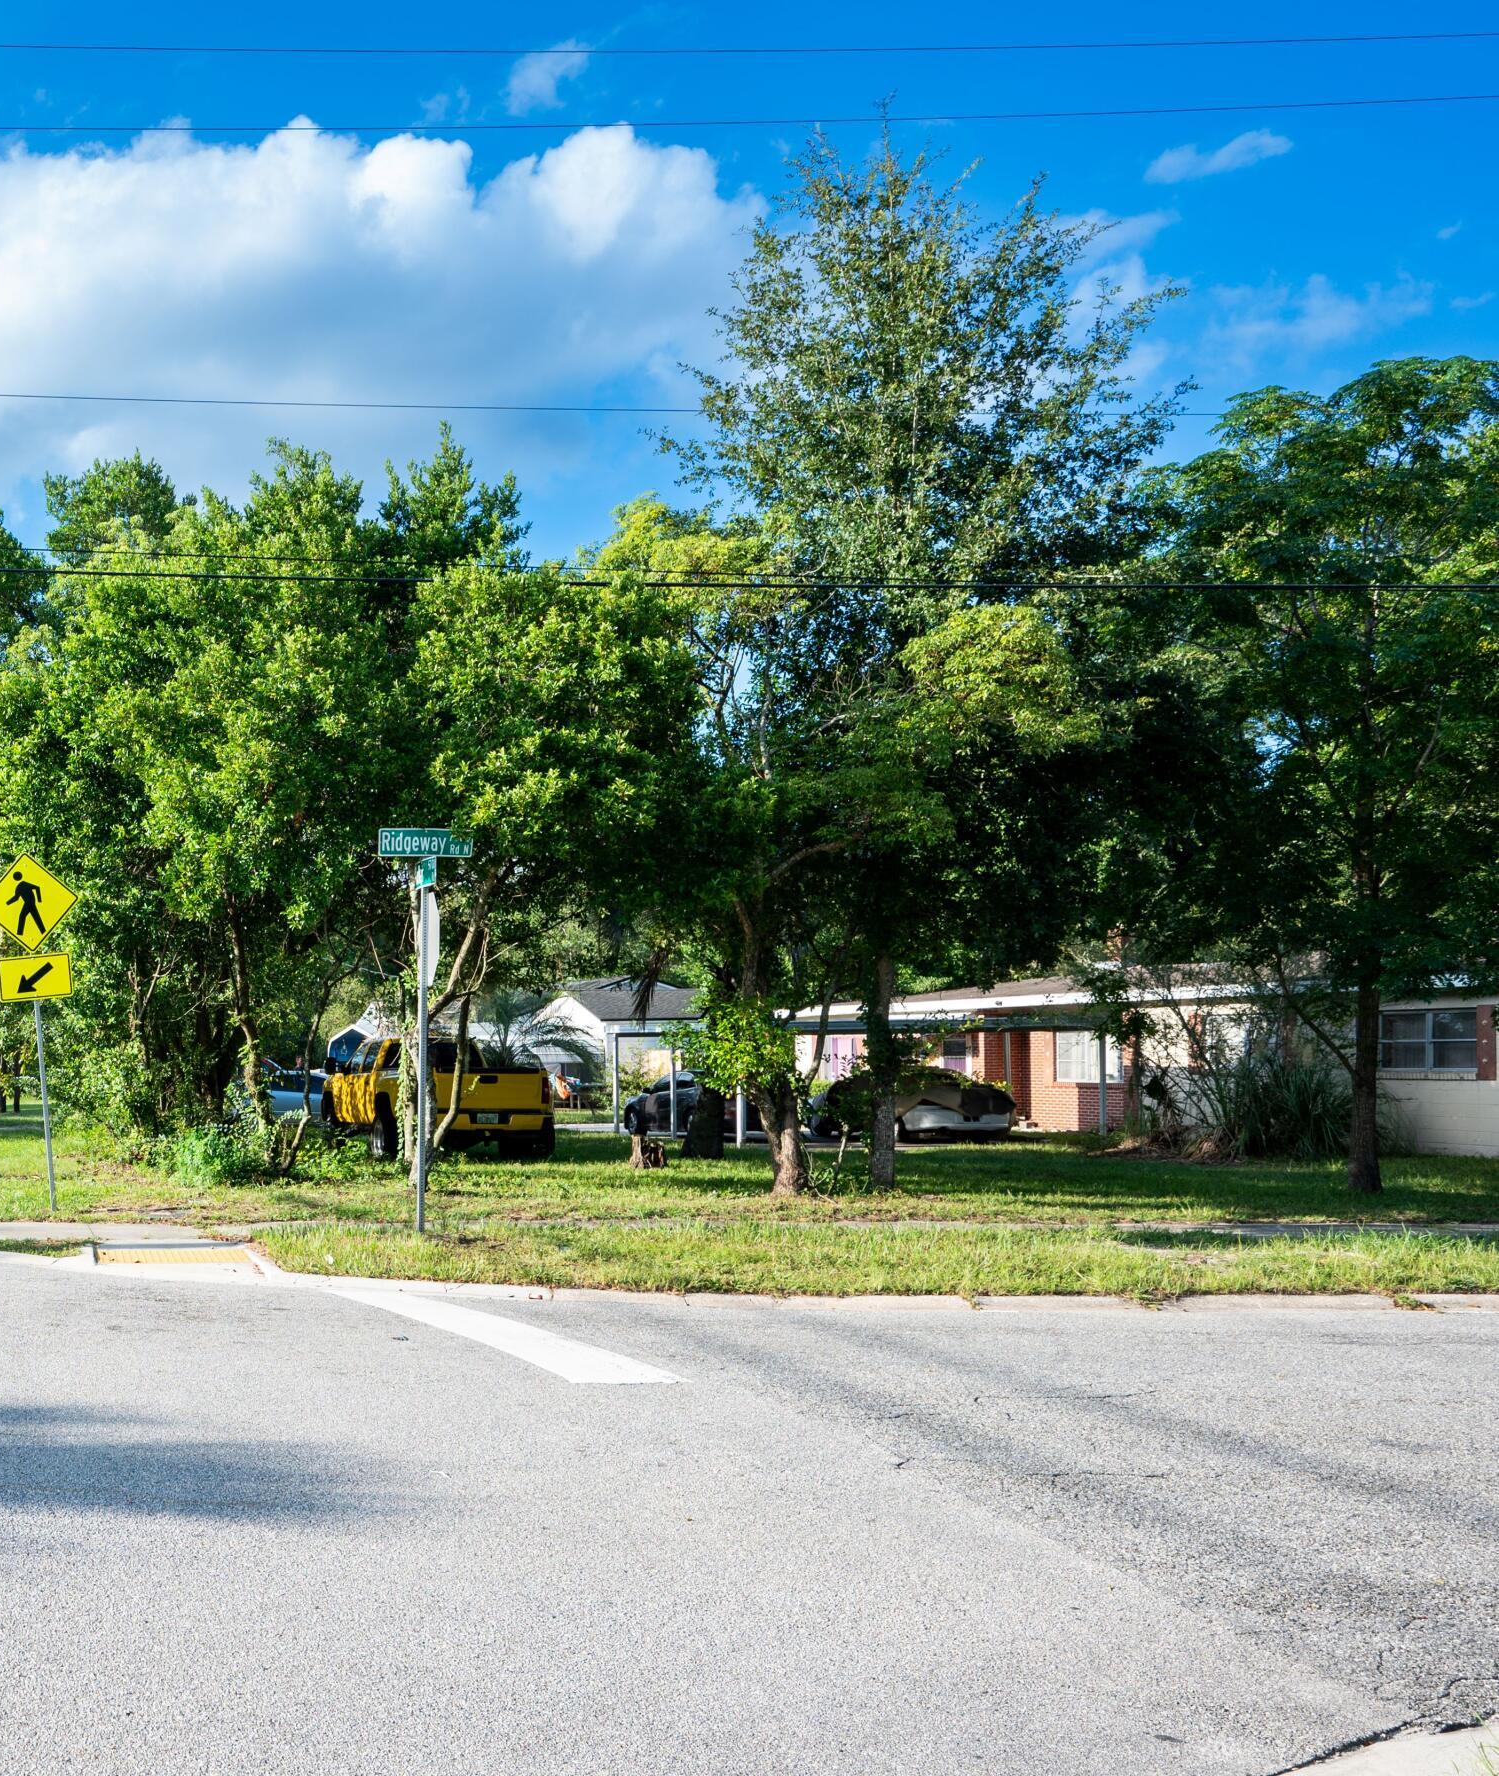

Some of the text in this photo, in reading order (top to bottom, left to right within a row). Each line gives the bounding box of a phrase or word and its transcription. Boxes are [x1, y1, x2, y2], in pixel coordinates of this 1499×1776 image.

[381, 832, 446, 854] Ridgeway
[449, 844, 459, 854] Rd
[463, 844, 469, 854] N
